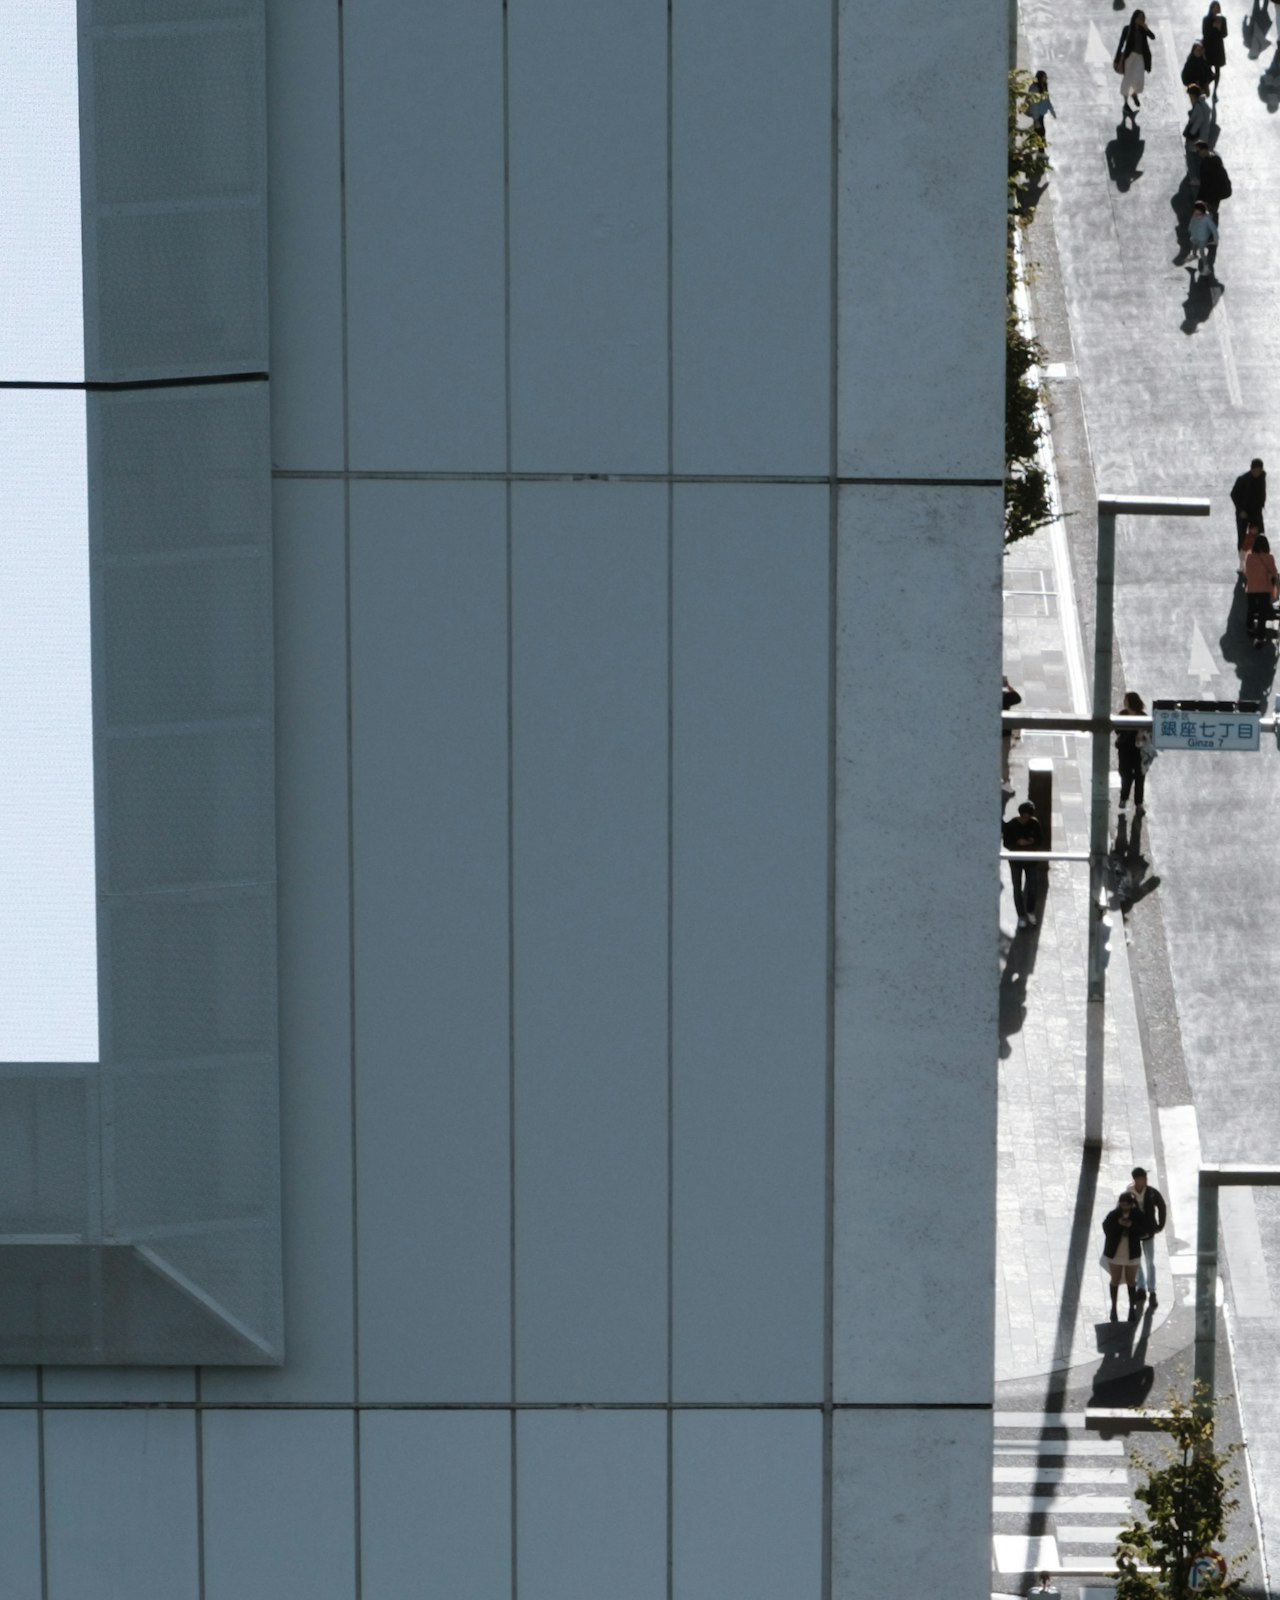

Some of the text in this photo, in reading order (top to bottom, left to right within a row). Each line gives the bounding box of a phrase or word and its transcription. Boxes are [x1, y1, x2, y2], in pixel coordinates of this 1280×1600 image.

[1160, 721, 1253, 739] 銀座七丁目
[1187, 737, 1225, 748] Ginza 7
